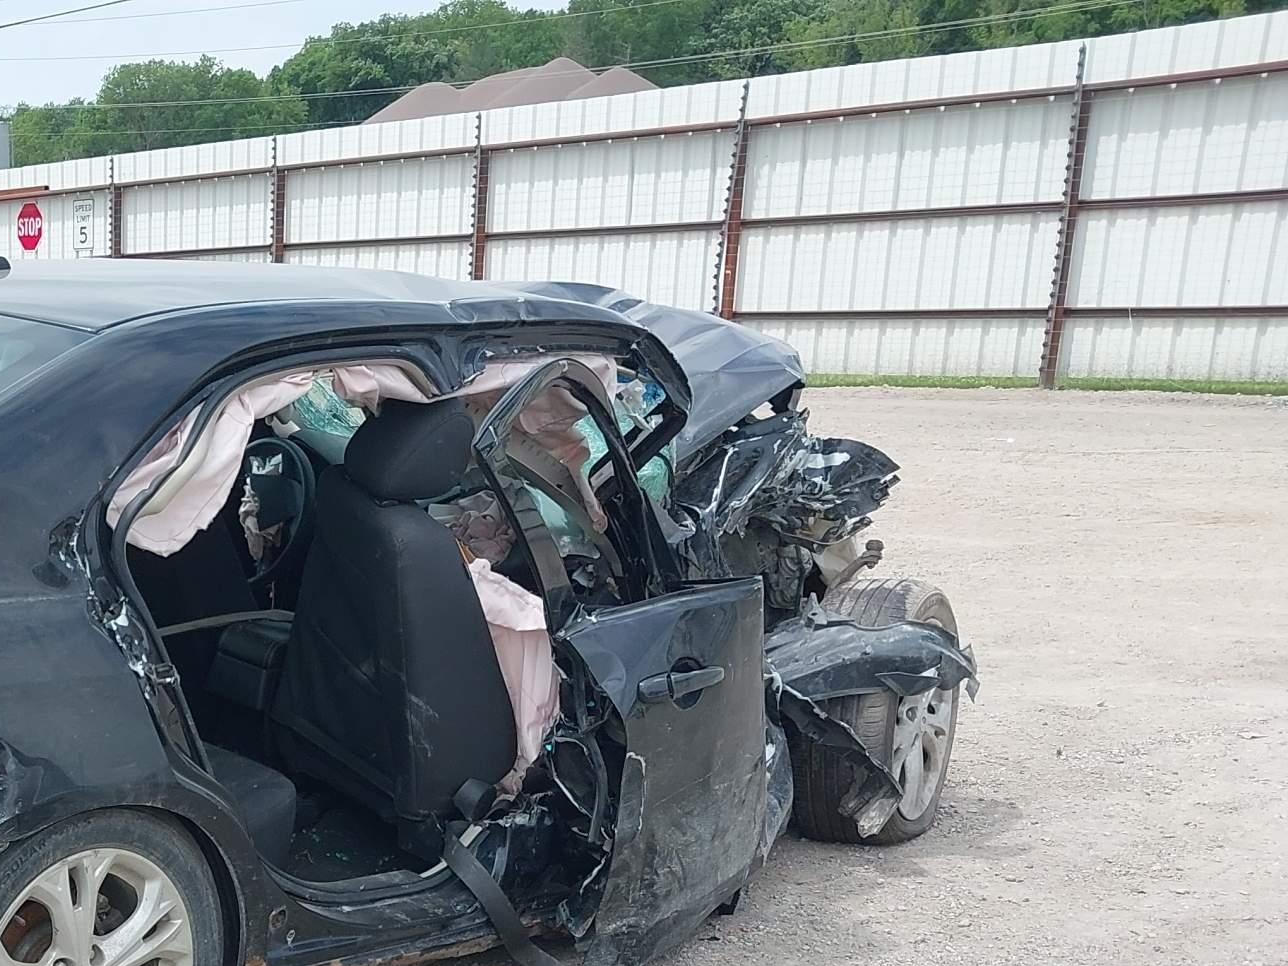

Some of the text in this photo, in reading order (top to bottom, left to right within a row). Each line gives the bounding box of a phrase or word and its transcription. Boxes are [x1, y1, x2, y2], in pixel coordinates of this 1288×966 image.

[74, 204, 92, 212] SPEED
[76, 215, 90, 223] LIMIT
[18, 217, 42, 237] STOP
[79, 226, 88, 244] 5
